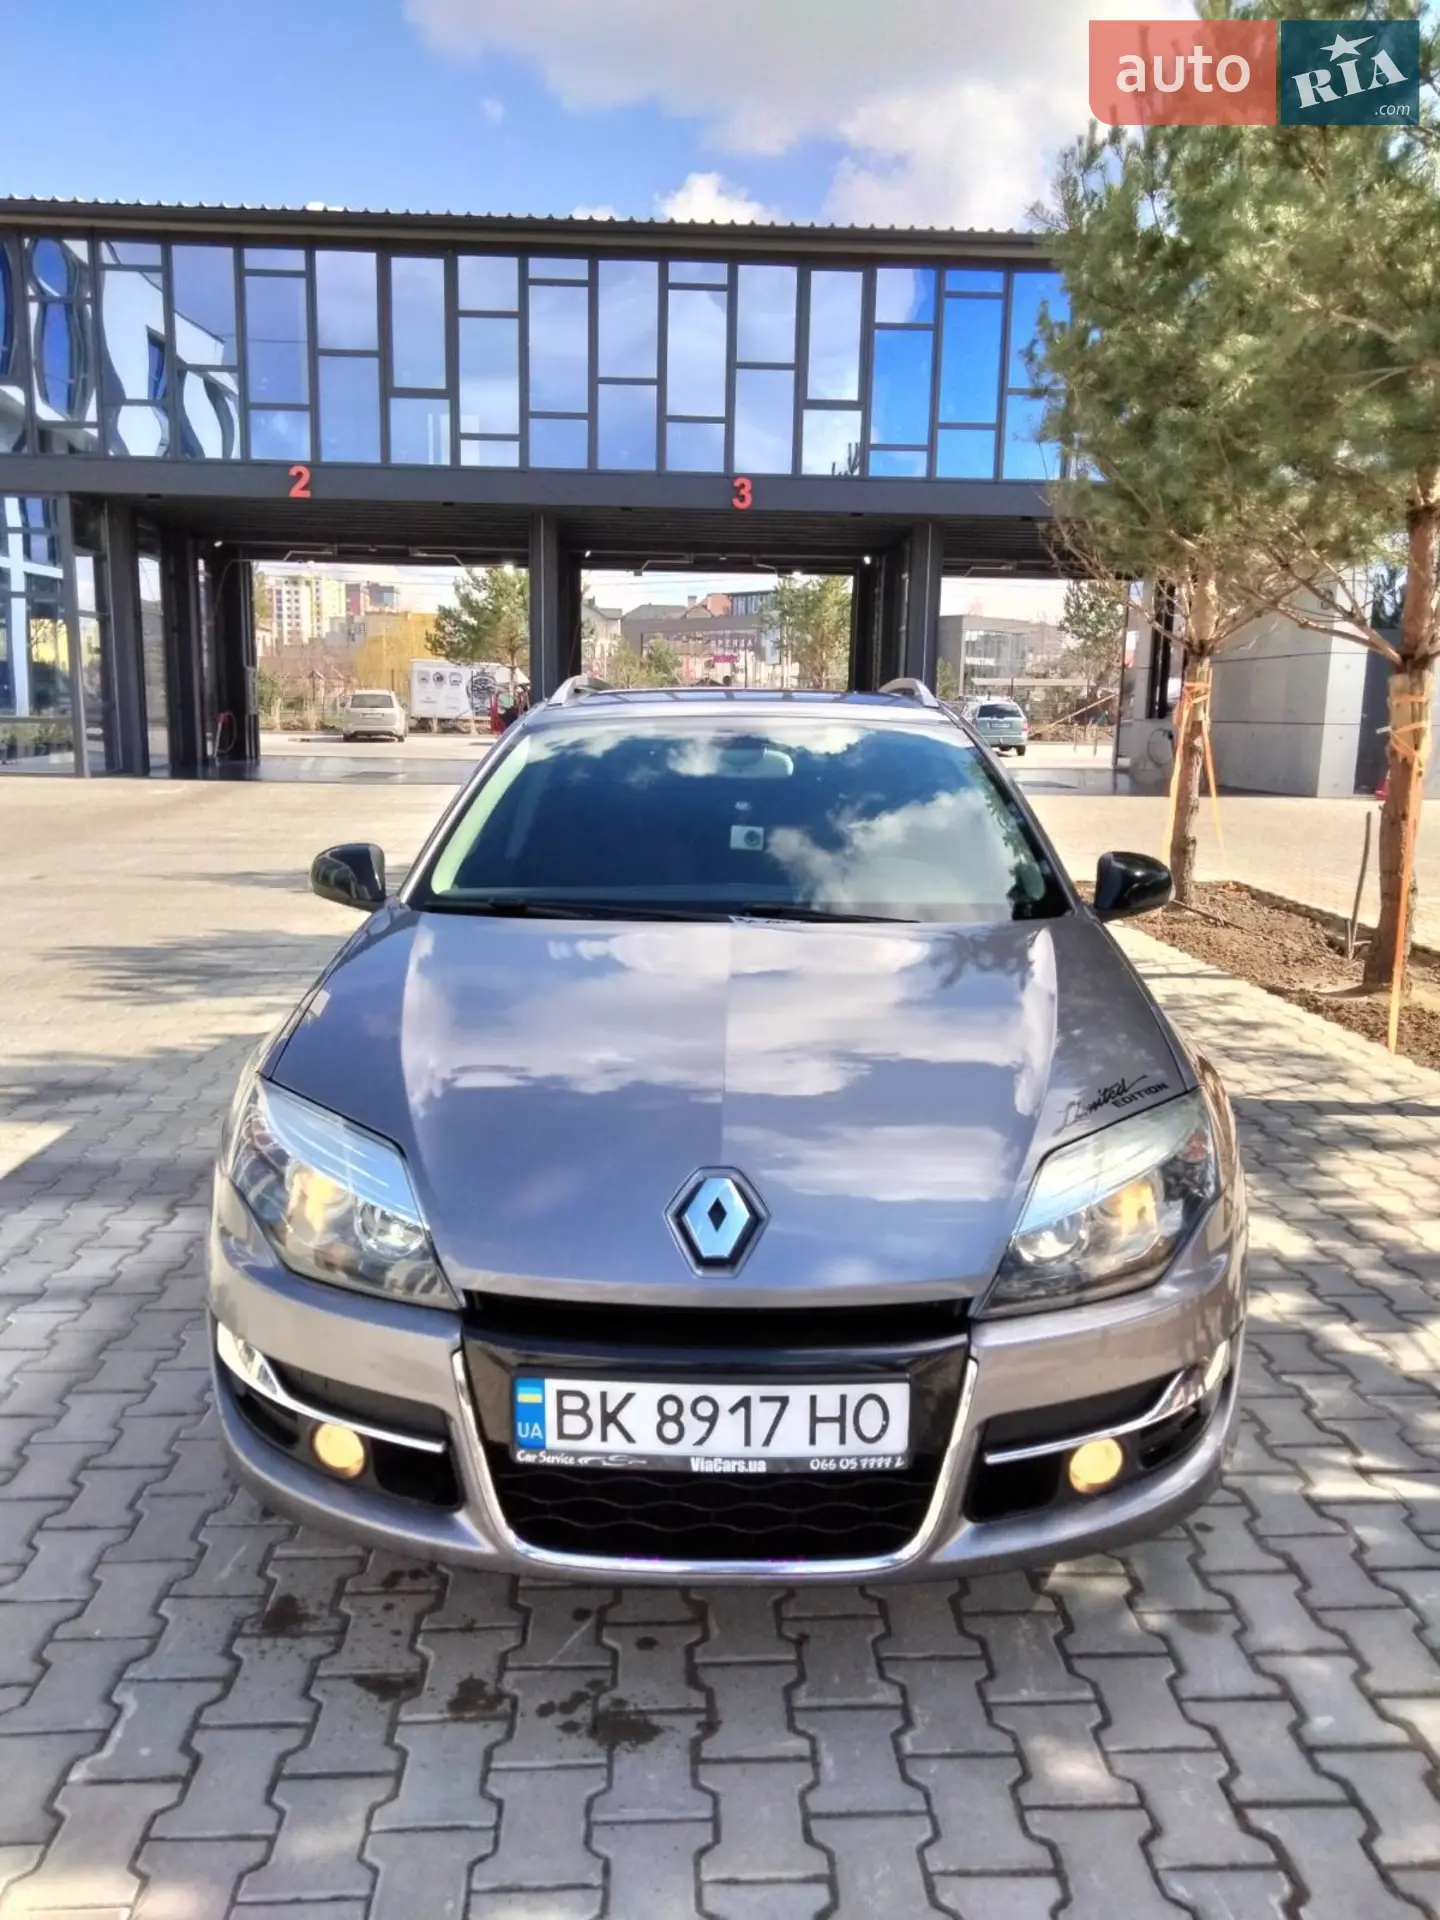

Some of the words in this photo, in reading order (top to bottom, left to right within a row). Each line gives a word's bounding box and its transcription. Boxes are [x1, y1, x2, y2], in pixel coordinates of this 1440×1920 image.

[288, 465, 312, 498] 2
[732, 477, 752, 510] 3
[1112, 1082, 1170, 1108] EDITION
[517, 1422, 543, 1439] UA
[556, 1389, 637, 1444] BK
[656, 1394, 790, 1447] 8917
[809, 1393, 890, 1446] HO
[516, 1450, 537, 1462] Car
[539, 1451, 576, 1465] Service
[809, 1458, 837, 1471] 066
[839, 1458, 858, 1470] 05
